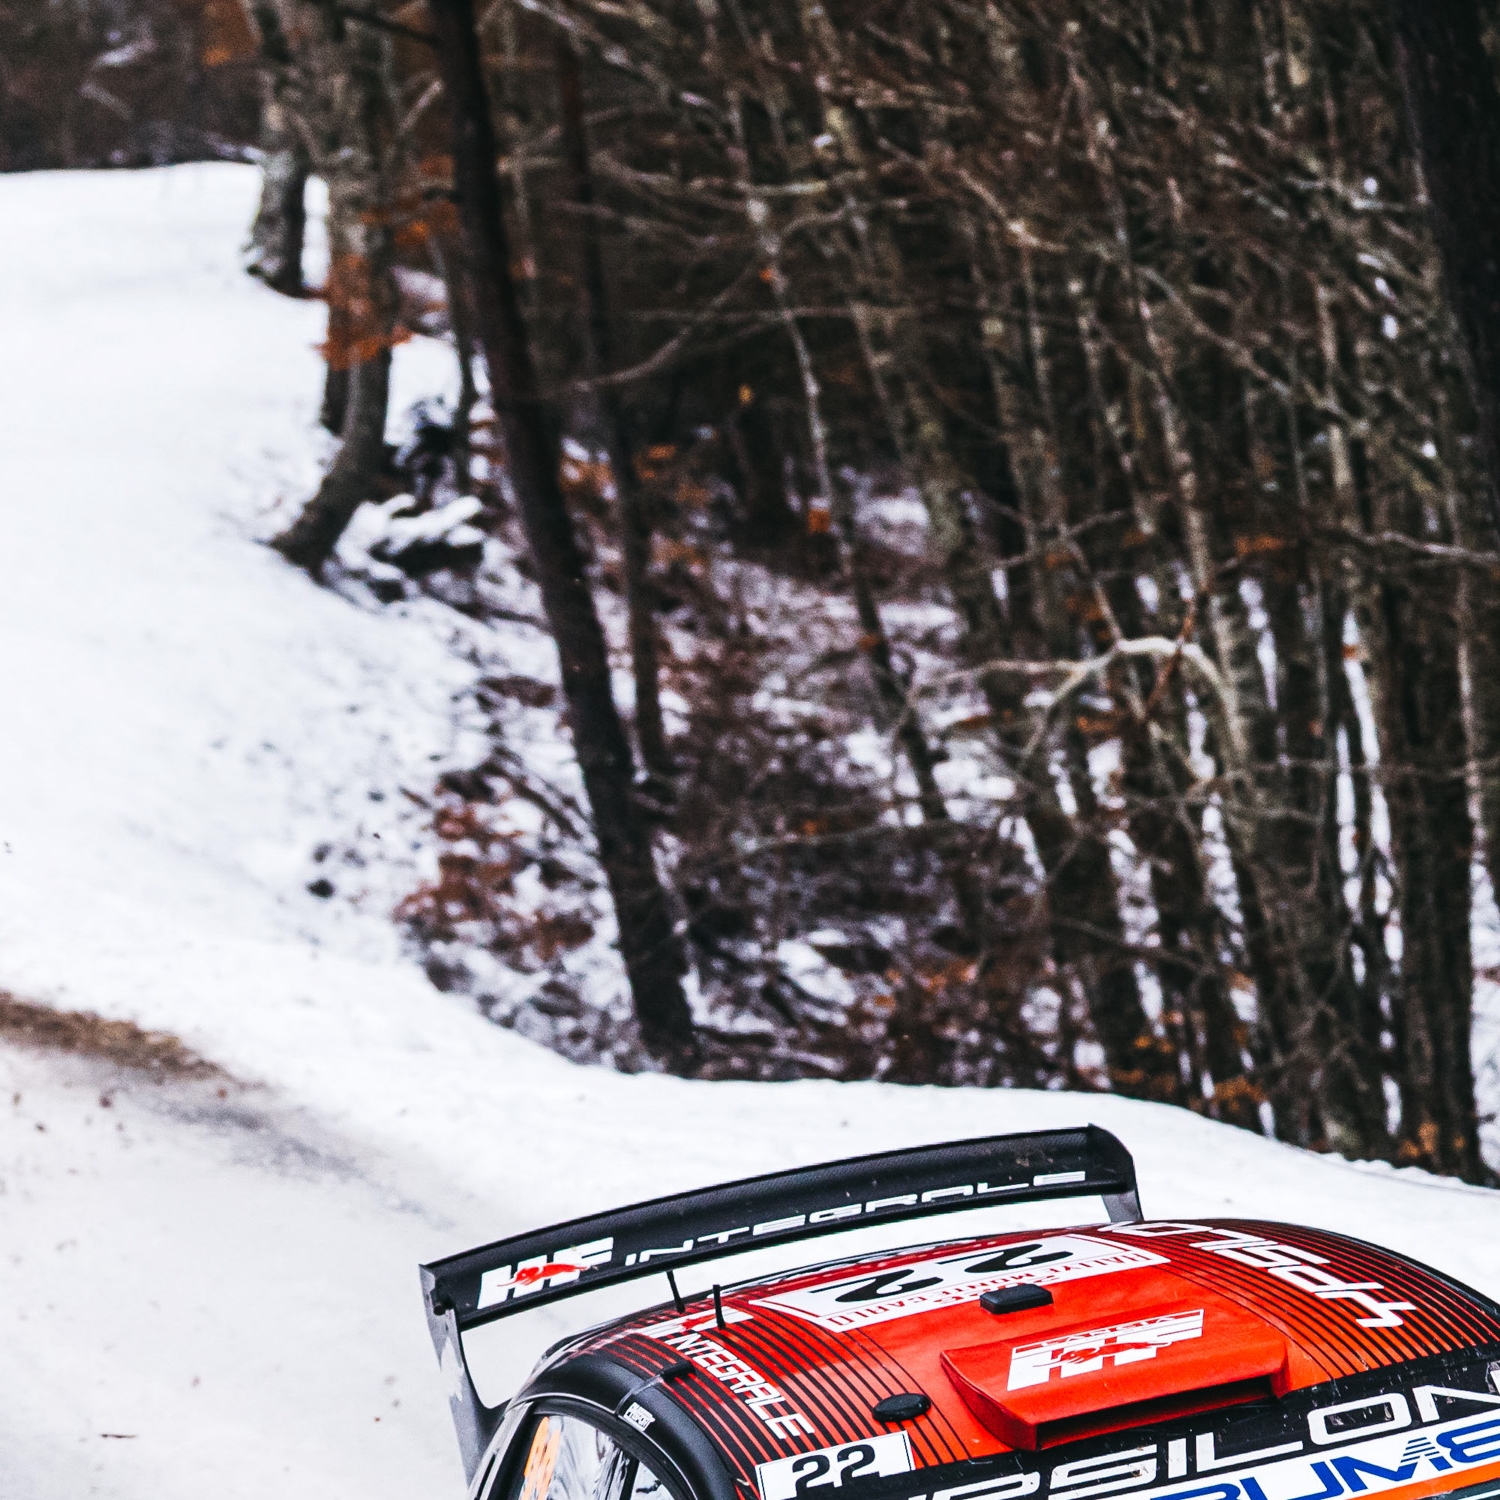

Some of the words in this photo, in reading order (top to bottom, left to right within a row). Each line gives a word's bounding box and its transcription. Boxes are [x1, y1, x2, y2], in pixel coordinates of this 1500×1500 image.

[625, 1170, 1086, 1266] INTEGRALE
[808, 1243, 1074, 1303] 22
[791, 1443, 876, 1491] 22
